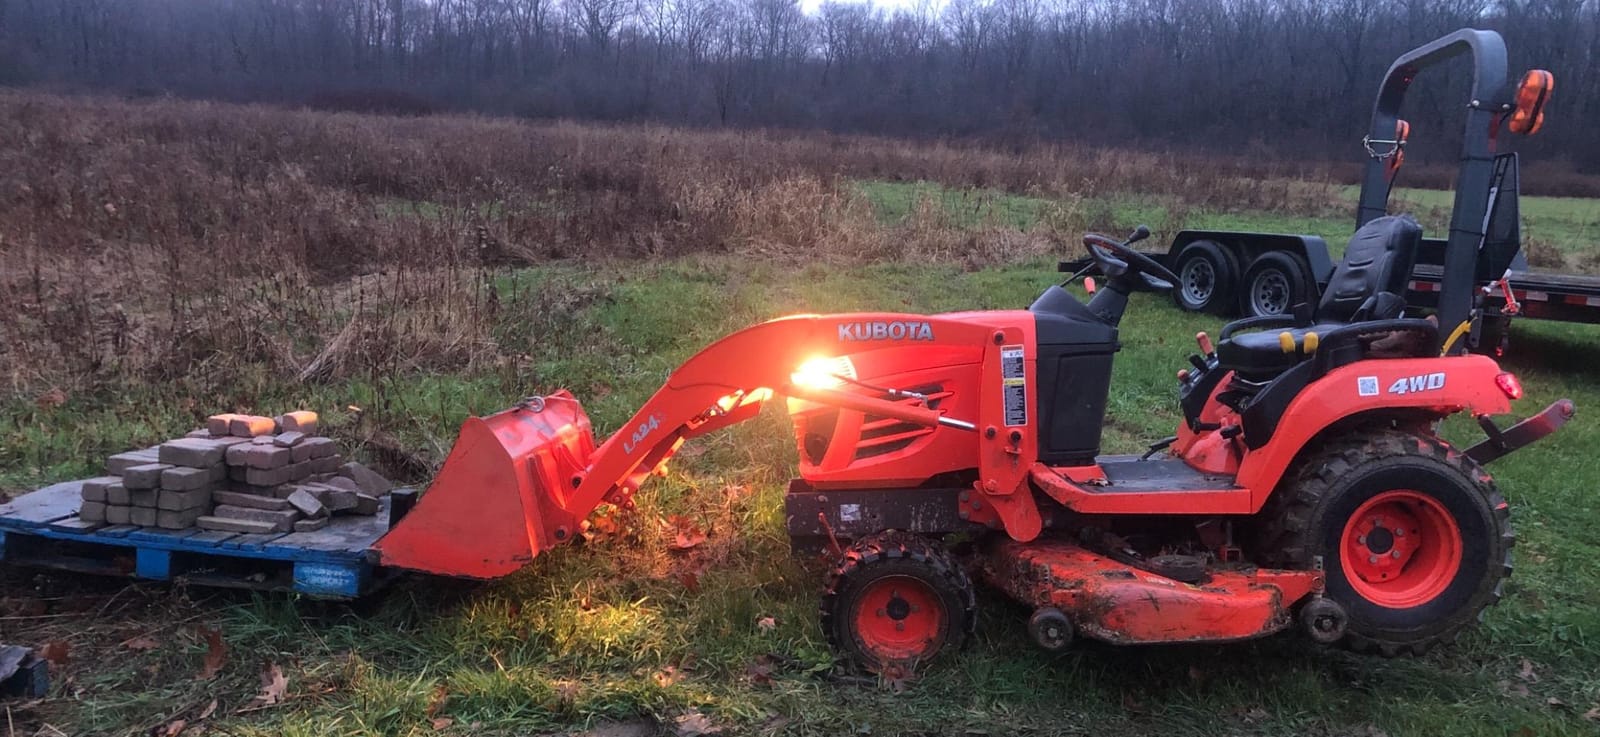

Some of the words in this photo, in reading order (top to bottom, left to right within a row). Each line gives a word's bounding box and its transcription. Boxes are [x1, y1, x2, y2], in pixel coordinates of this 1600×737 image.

[838, 321, 934, 341] KUBOTA
[1388, 372, 1446, 394] 4WD
[622, 413, 665, 455] LA24
